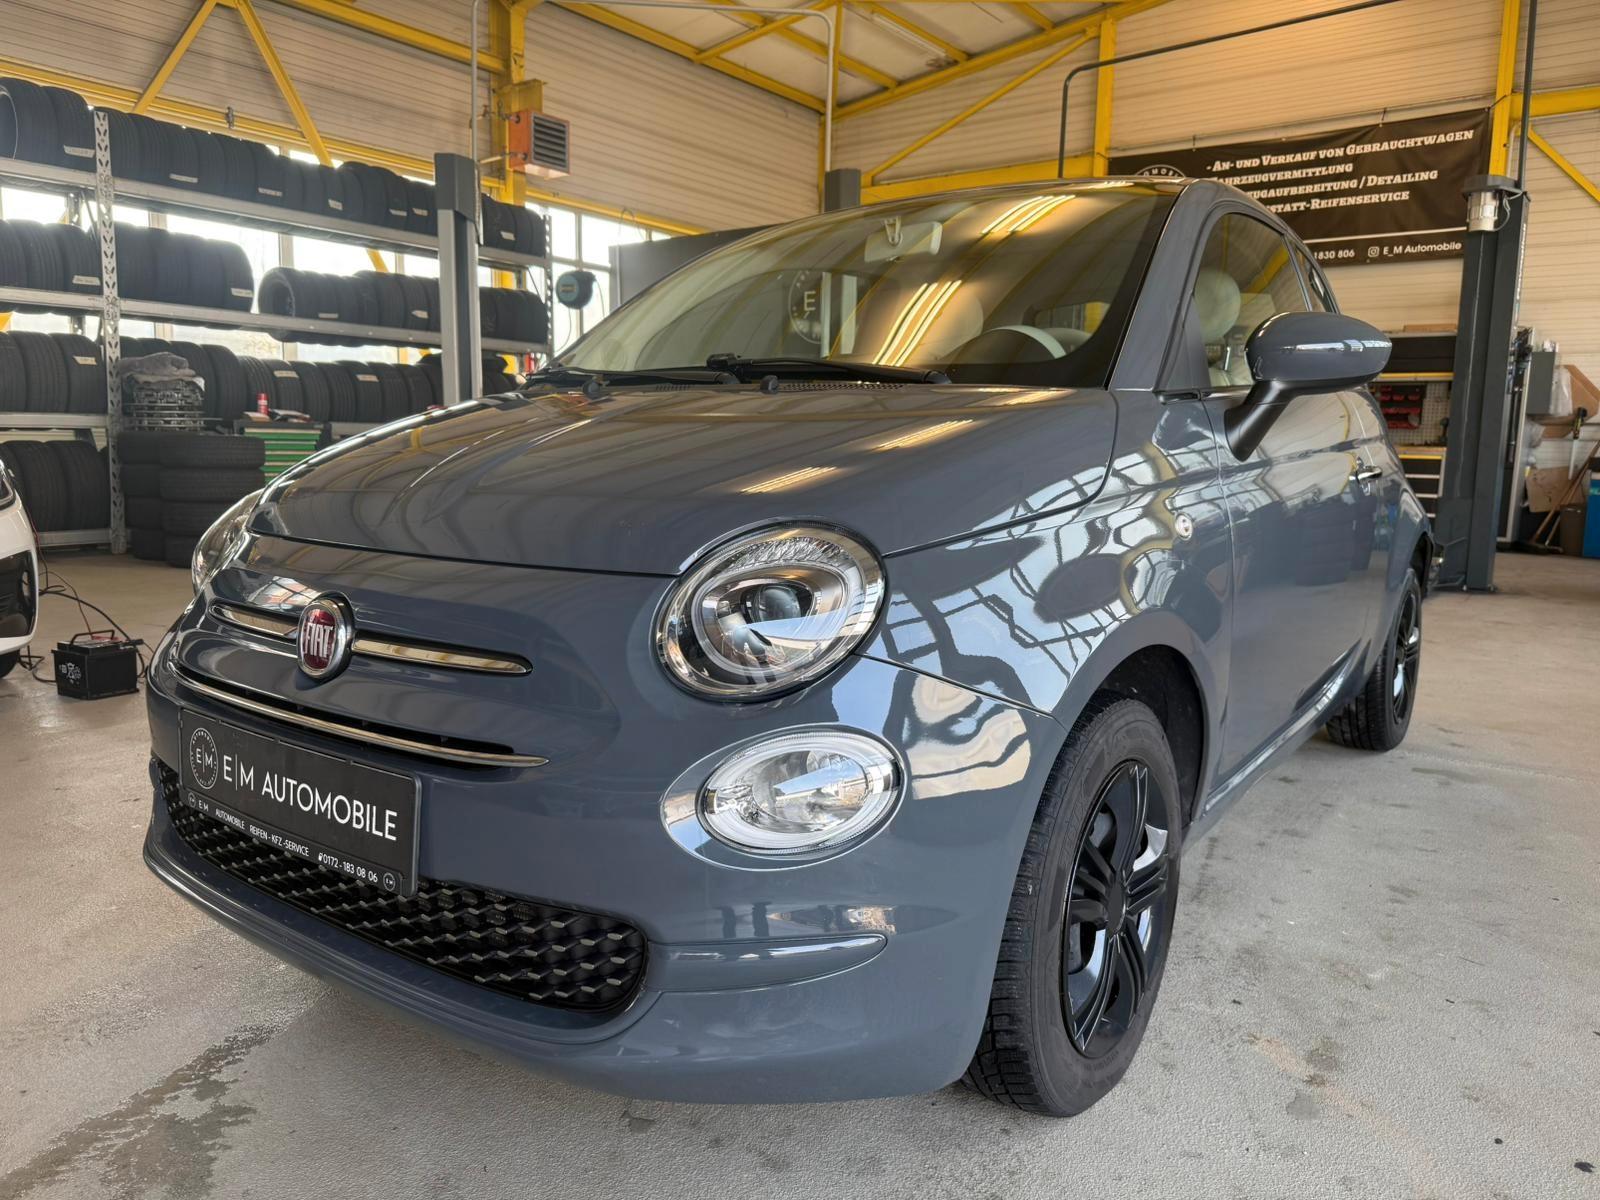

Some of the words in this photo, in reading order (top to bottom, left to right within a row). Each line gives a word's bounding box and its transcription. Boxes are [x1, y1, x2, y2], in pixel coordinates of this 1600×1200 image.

[1236, 158, 1260, 169] UND
[1261, 150, 1317, 166] VERKAUF
[1318, 147, 1345, 159] VON
[1346, 129, 1474, 156] GEBRAUCHTWAGEN
[1366, 170, 1438, 187] DETAILING
[1337, 249, 1355, 259] 806
[1383, 246, 1403, 257] E_M
[1404, 241, 1463, 254] Automobile
[305, 622, 334, 658] FIAT
[261, 771, 398, 841] AUTOMOBILE
[215, 808, 245, 830] AUTOMOBILE
[368, 870, 379, 883] 06
